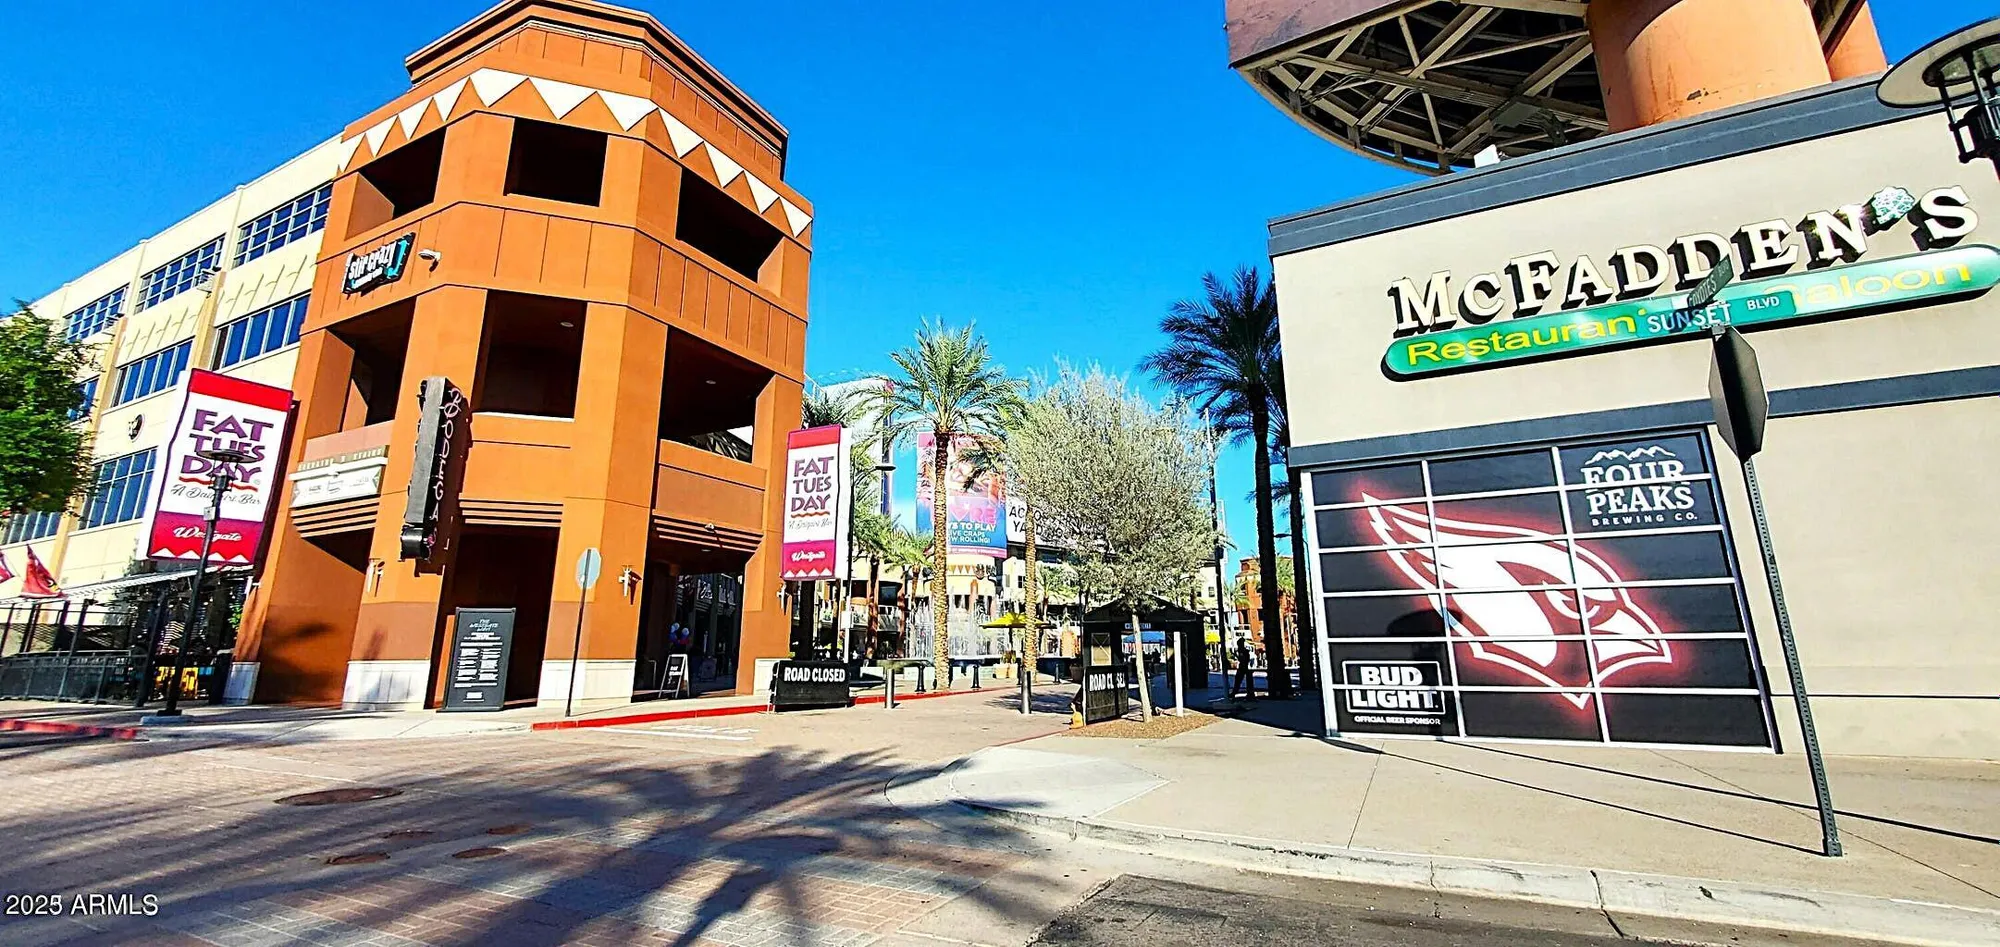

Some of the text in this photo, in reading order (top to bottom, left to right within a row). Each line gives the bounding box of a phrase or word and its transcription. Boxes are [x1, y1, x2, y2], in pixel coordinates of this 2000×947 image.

[1647, 296, 1780, 333] SUNSET BLVD
[1407, 308, 1646, 365] Restauran
[192, 408, 274, 442] FAT
[189, 432, 265, 461] TUES
[180, 454, 262, 483] DAY
[794, 456, 834, 477] FAT
[1580, 460, 1684, 485] FOUR
[792, 476, 832, 494] TUES
[791, 494, 831, 512] DAY
[1585, 482, 1695, 516] PEAKS
[961, 522, 972, 530] TO
[974, 523, 996, 532] PLAY
[1591, 512, 1698, 526] BREWING CO.
[784, 667, 846, 683] ROAD CLOSED
[1089, 673, 1106, 692] ROAD
[1360, 666, 1423, 686] BUD
[1354, 715, 1385, 723] OFFICIAL
[1405, 717, 1441, 725] SPONSOR
